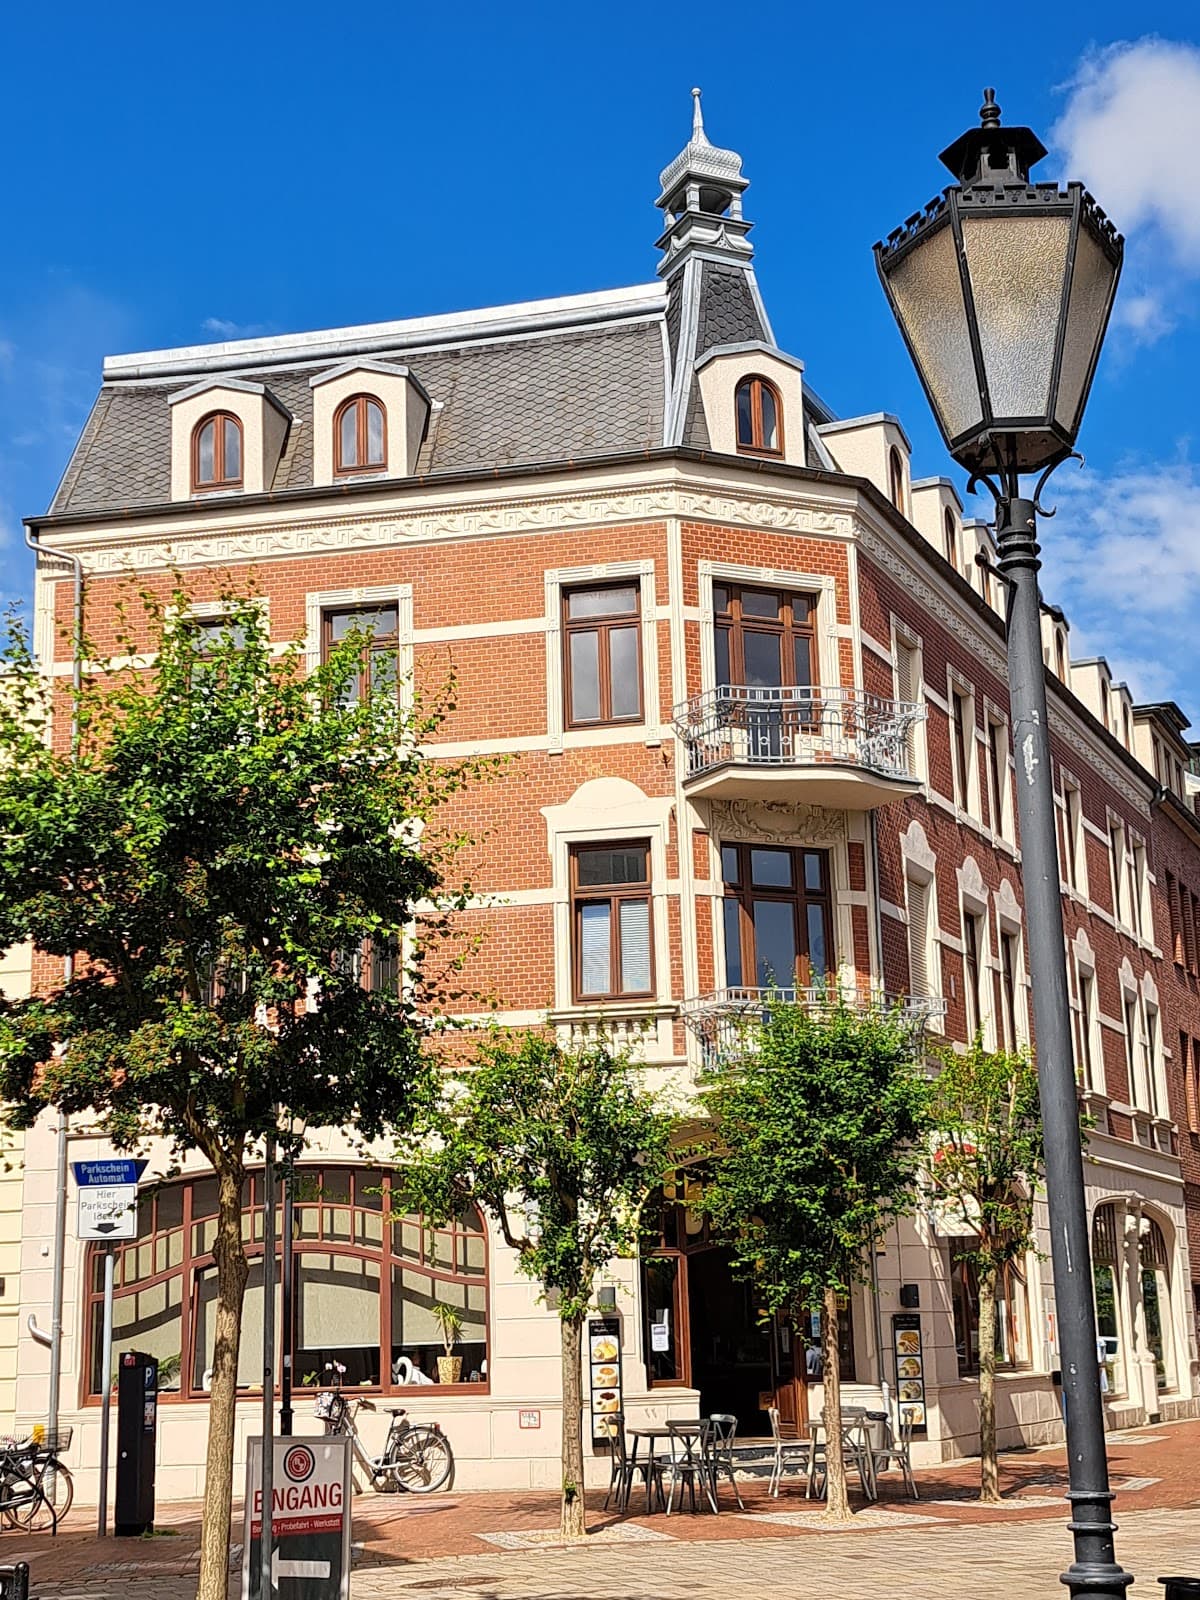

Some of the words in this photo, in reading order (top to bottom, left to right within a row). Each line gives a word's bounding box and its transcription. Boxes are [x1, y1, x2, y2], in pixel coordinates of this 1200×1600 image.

[81, 1163, 130, 1174] Parkschein
[88, 1174, 126, 1184] Automat
[96, 1190, 116, 1199] Hier
[145, 1367, 152, 1385] P
[254, 1482, 342, 1514] ENGANG
[281, 1520, 310, 1530] Probefahrt
[313, 1518, 340, 1528] Werkstatt
